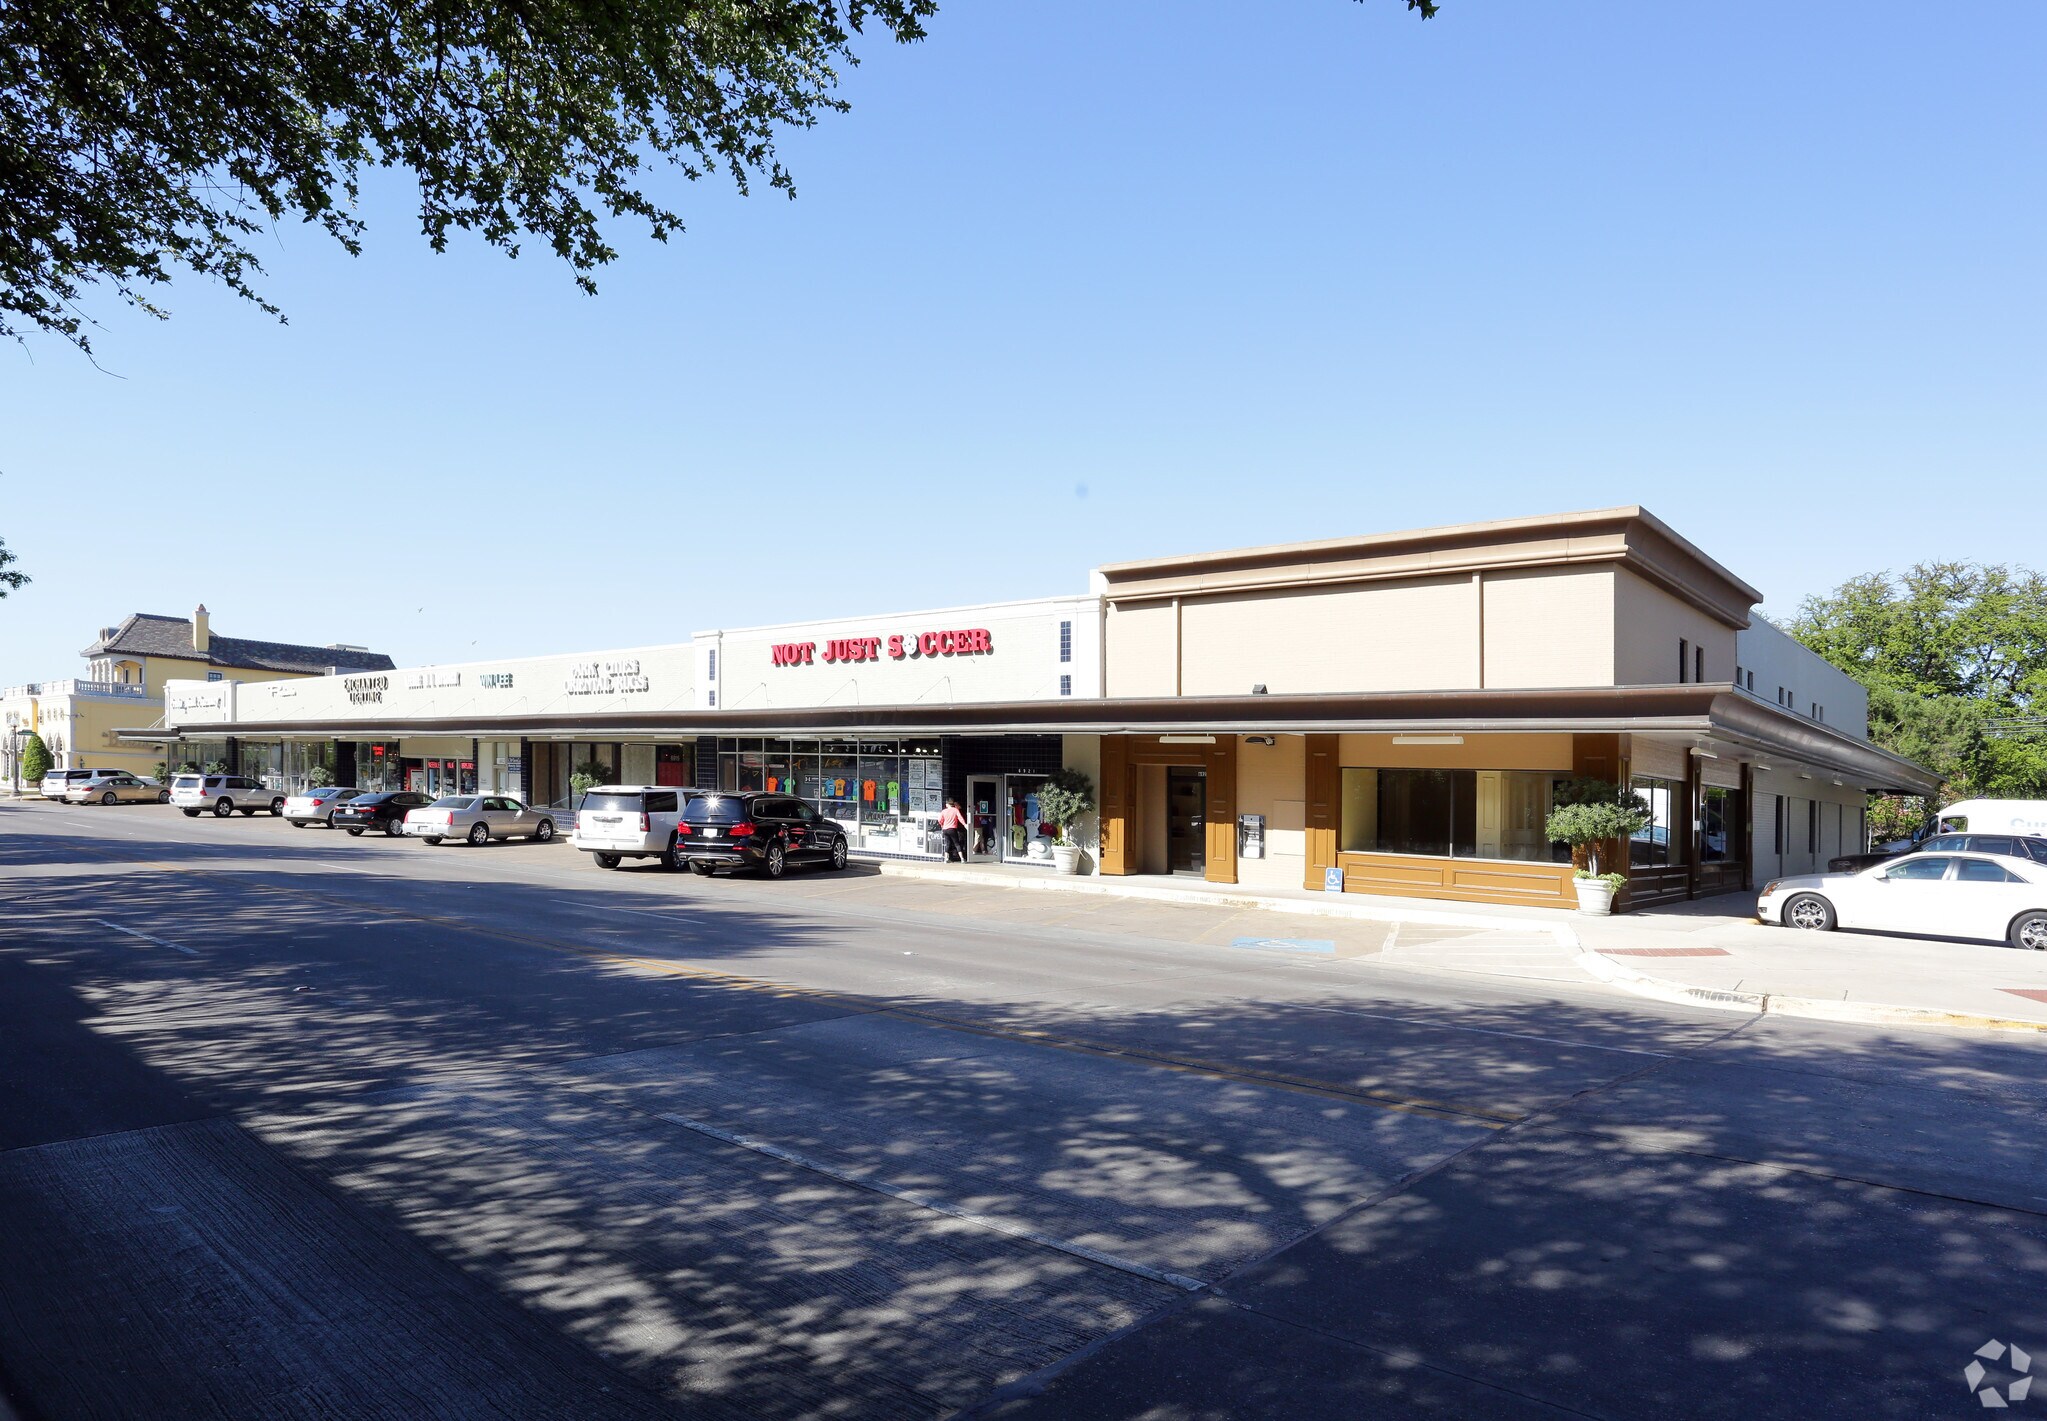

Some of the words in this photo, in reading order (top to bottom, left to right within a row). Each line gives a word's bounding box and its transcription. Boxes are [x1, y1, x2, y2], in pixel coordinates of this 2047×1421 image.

[771, 642, 815, 665] NOT
[821, 637, 880, 661] JUST
[888, 628, 991, 658] SOCCER
[344, 675, 389, 692] ENCHANTED
[619, 675, 649, 693] RUGS
[349, 691, 382, 705] LIGHTING
